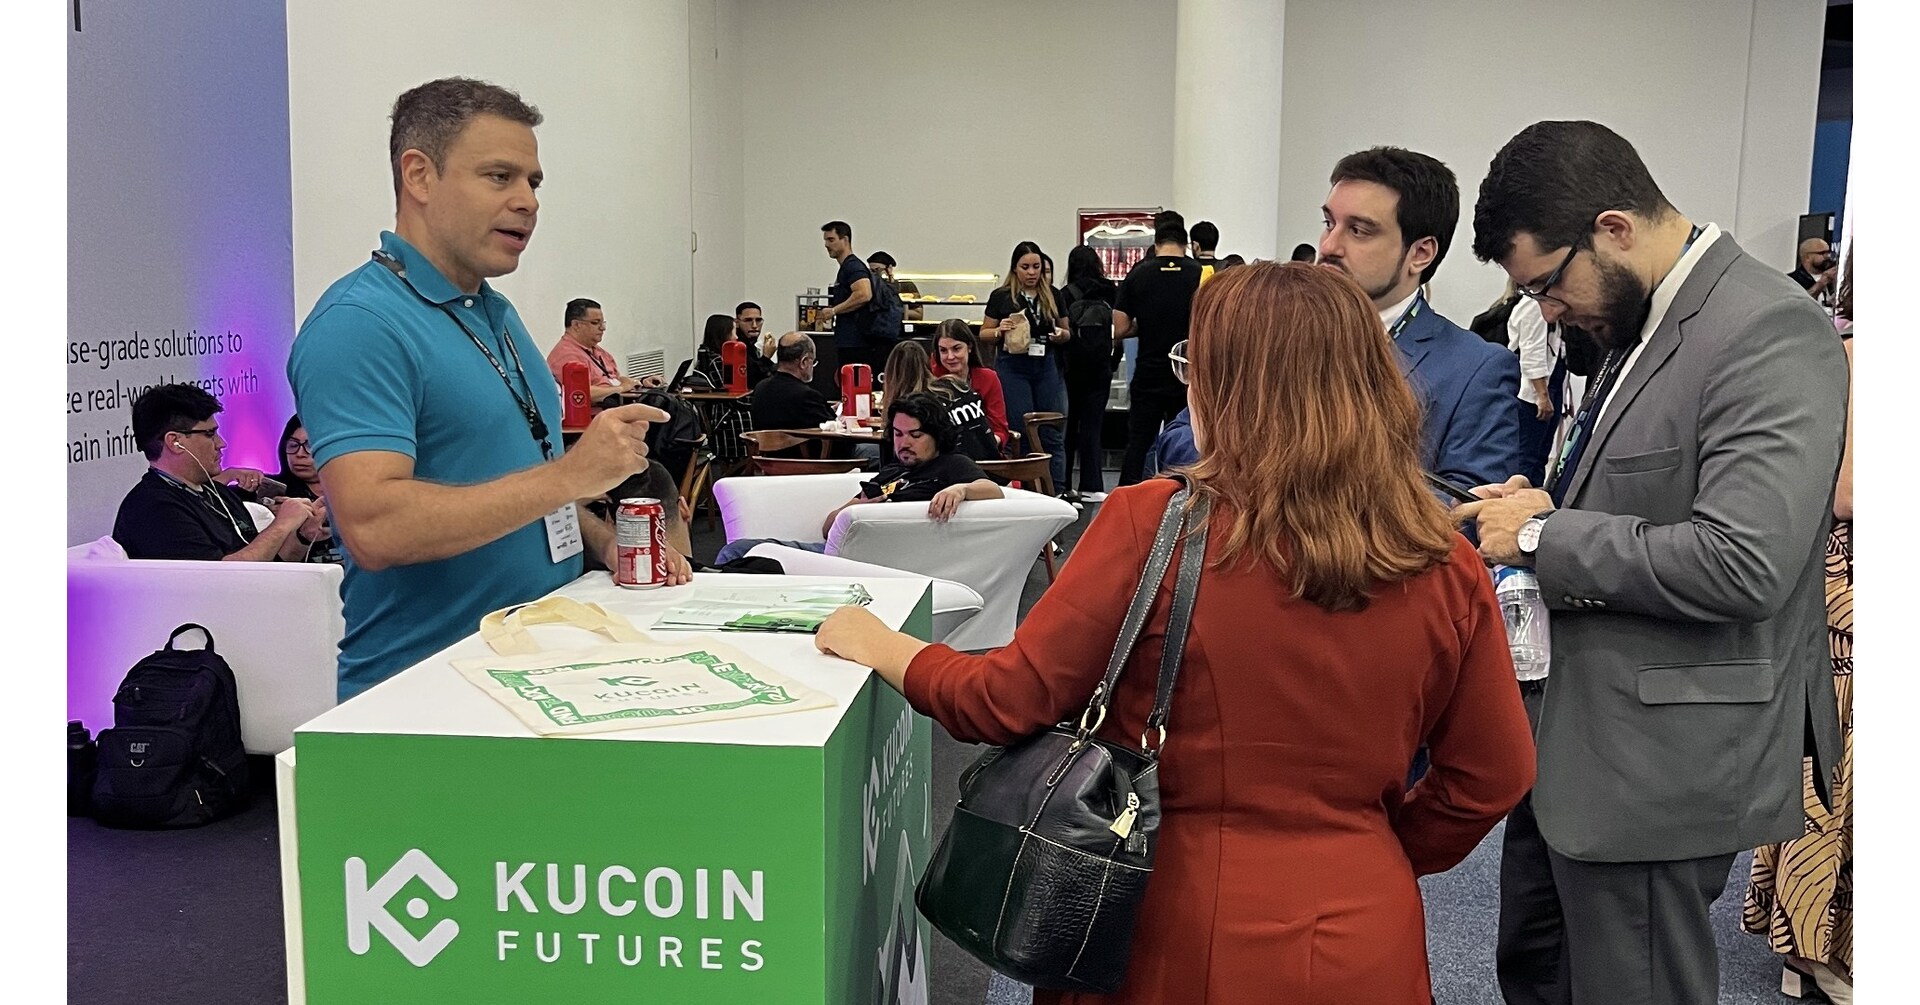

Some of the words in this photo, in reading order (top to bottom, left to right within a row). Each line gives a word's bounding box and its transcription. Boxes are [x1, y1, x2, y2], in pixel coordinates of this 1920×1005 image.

[154, 329, 224, 358] solutions
[227, 330, 243, 353] to
[88, 374, 174, 412] real-w
[227, 367, 258, 395] with
[593, 682, 702, 700] KUCOIN
[130, 742, 150, 753] CAT
[882, 702, 914, 794] KUCOIN
[882, 751, 914, 841] FUTURES
[495, 860, 764, 922] KUCOIN
[497, 930, 764, 972] FUTURES
